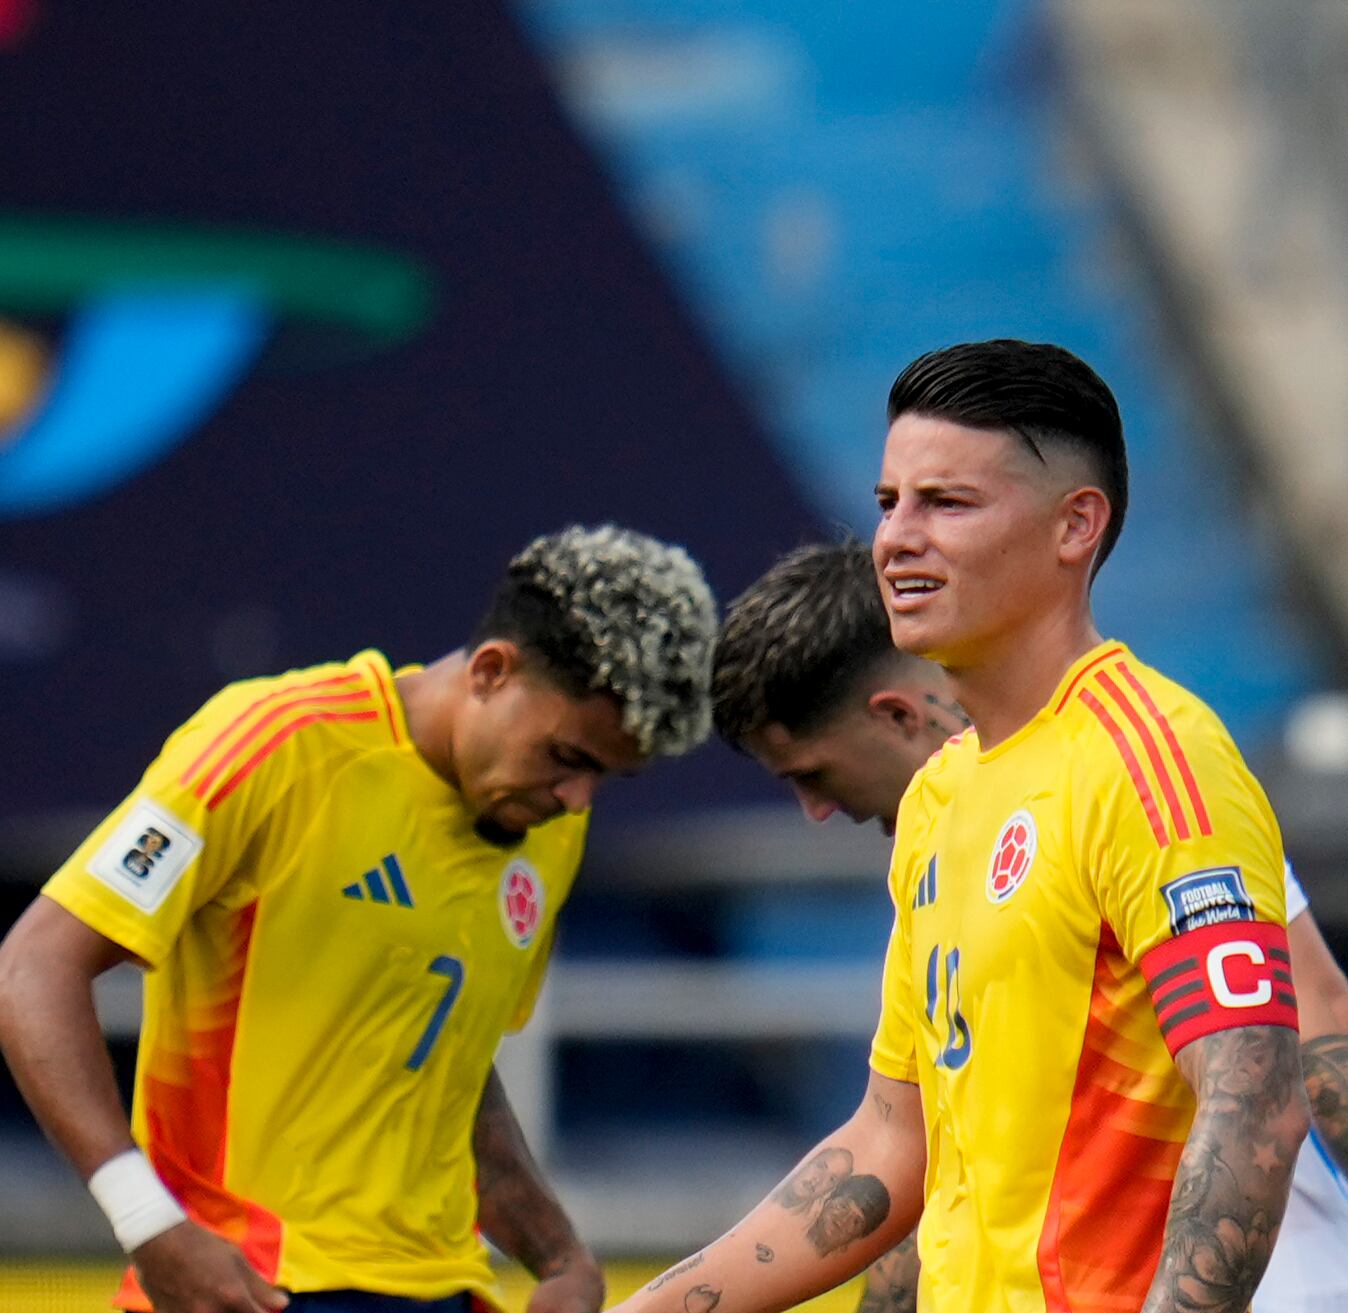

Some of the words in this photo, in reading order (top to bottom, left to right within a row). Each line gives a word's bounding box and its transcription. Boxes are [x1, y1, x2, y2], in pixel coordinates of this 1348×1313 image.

[1181, 881, 1230, 905] FOOTBALL
[1205, 940, 1272, 1008] C
[405, 955, 465, 1072] 7
